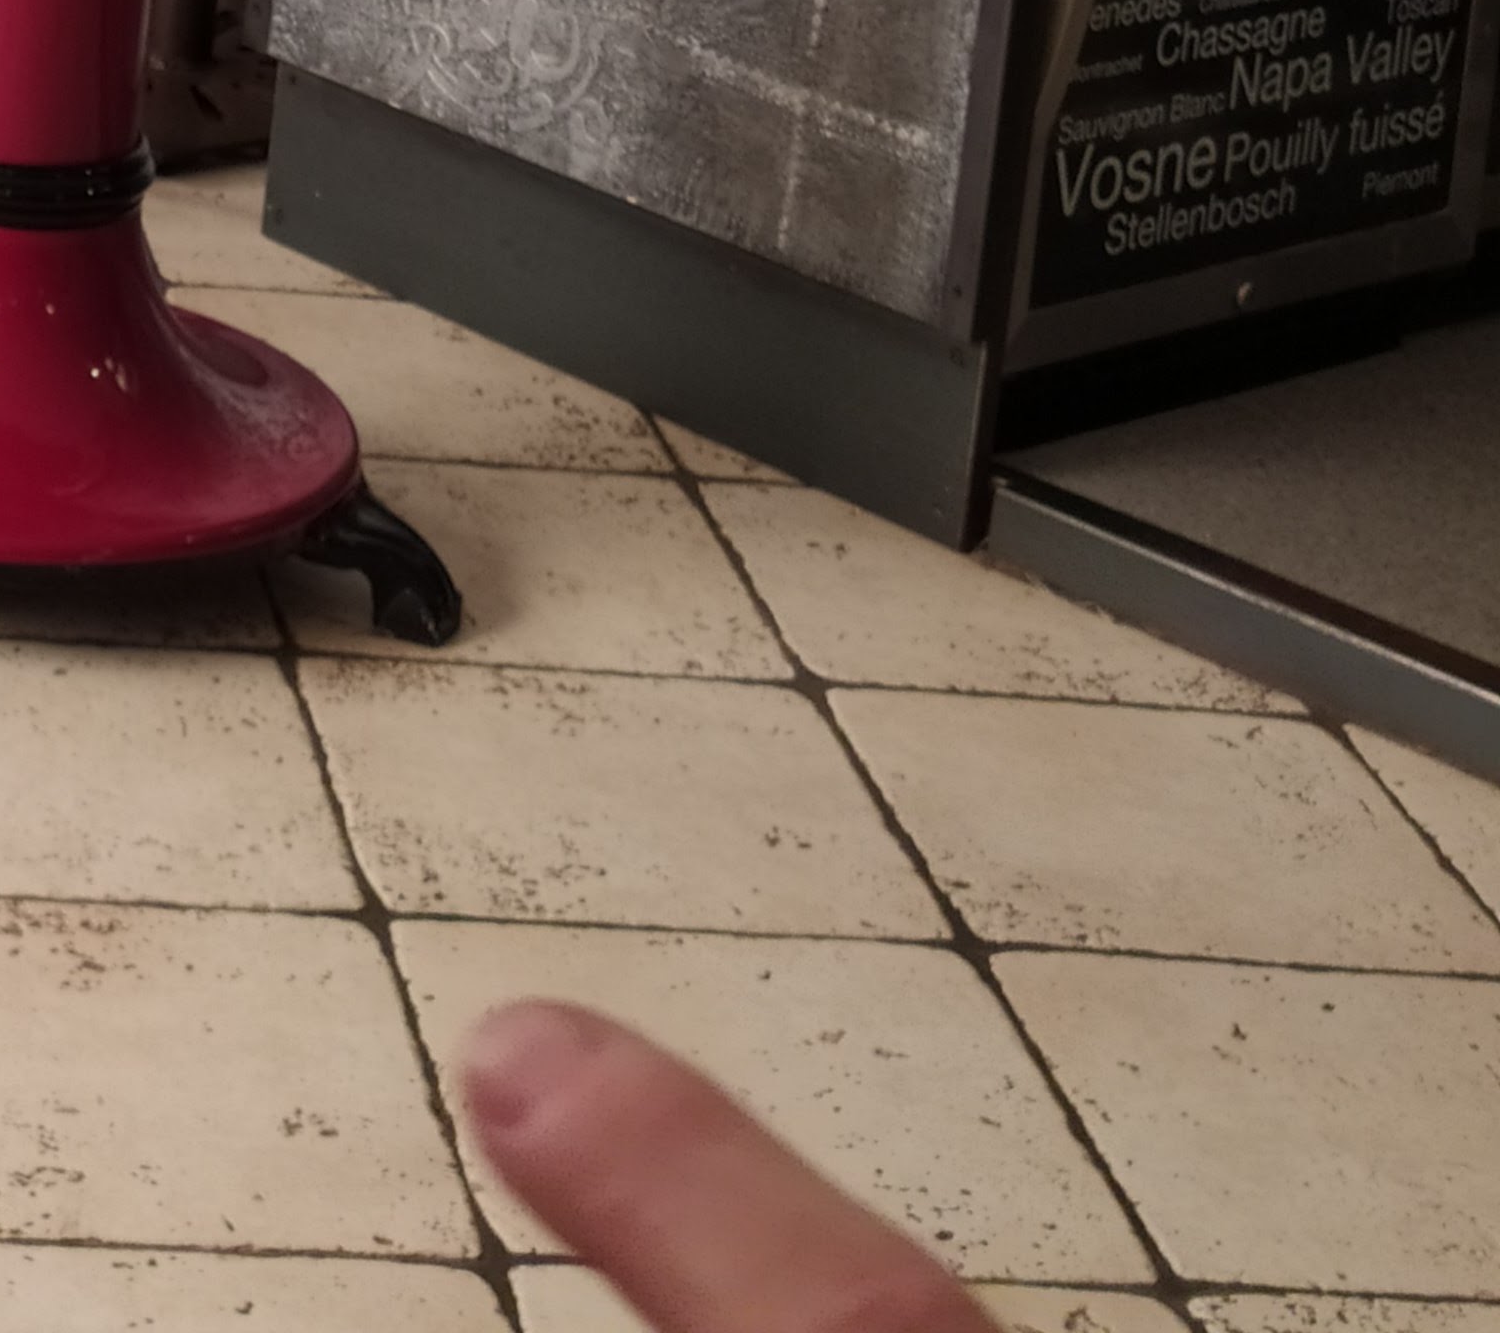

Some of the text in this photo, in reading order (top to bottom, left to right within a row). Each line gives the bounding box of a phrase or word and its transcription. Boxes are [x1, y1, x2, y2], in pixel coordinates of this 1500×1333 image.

[1057, 104, 1165, 146] Sauvignon
[1229, 51, 1333, 113] Napa
[1347, 25, 1456, 85] Valley
[1156, 5, 1326, 68] Chassagne
[1056, 89, 1446, 217] Vosne Pouilly fuissé
[1103, 177, 1297, 256] Stellenbosch
